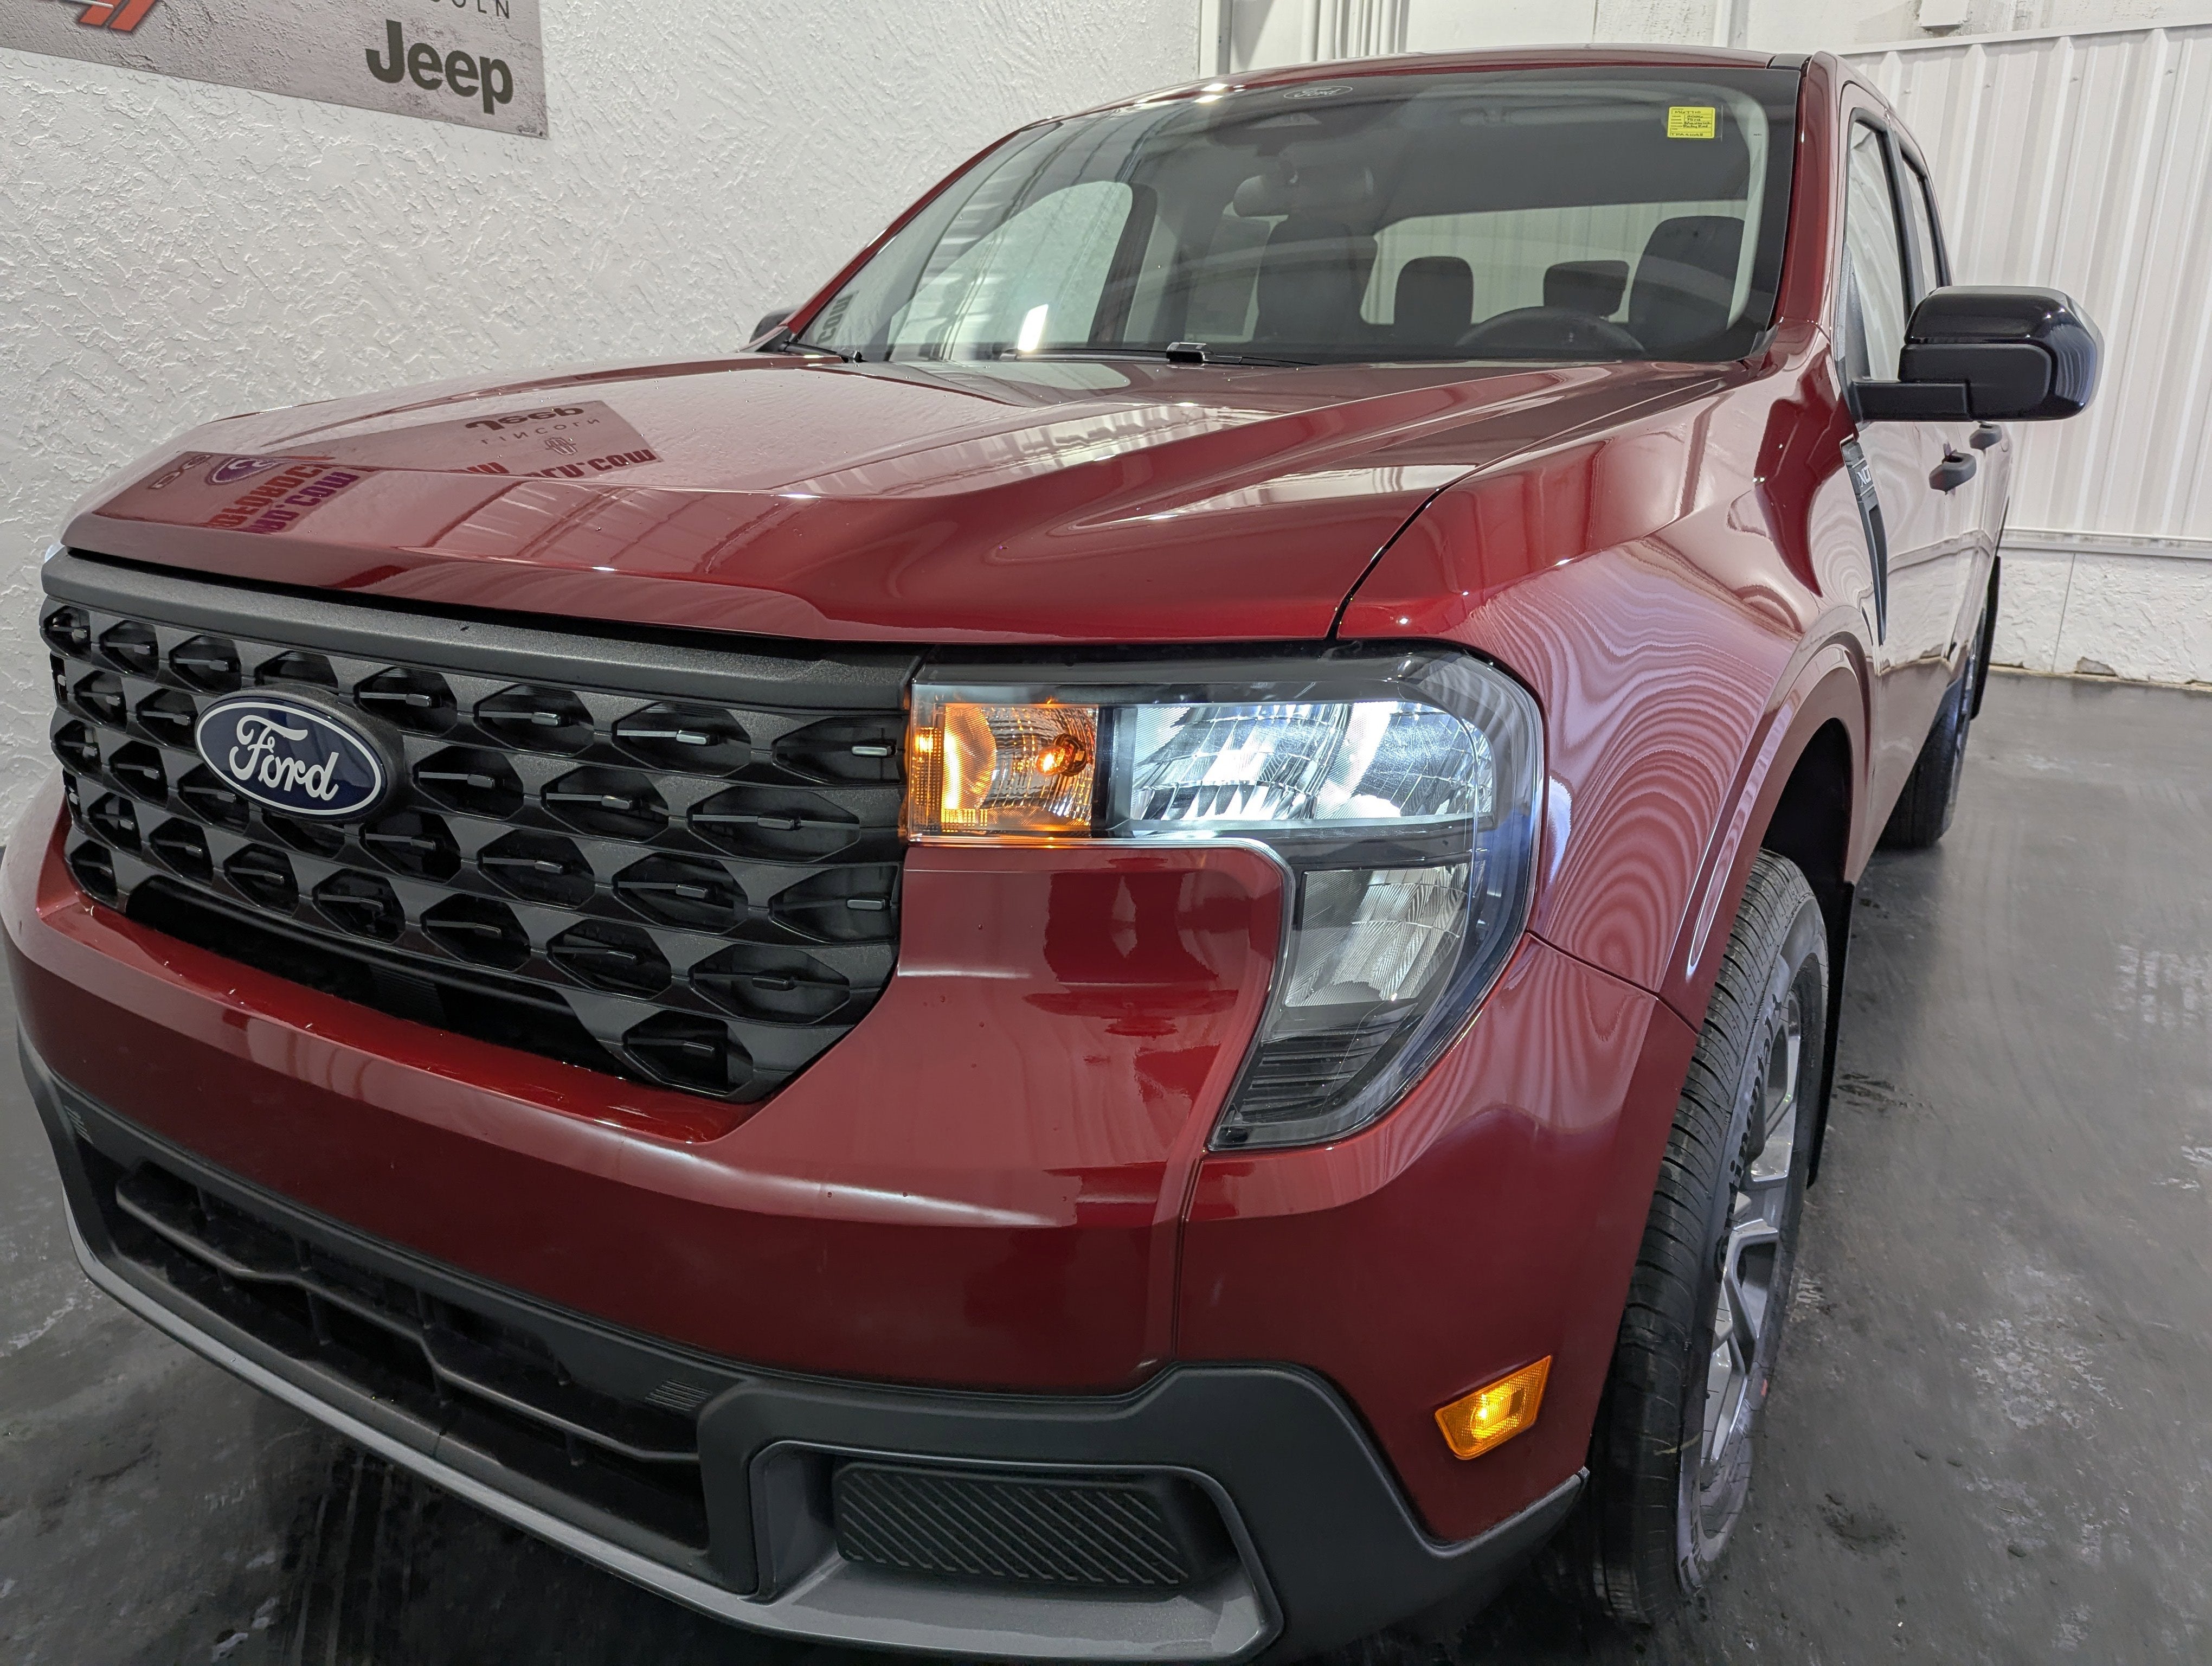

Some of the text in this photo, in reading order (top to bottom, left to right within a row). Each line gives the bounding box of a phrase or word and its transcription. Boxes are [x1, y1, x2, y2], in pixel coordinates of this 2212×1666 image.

[365, 19, 513, 116] Jeep
[1294, 87, 1341, 98] Ford
[229, 715, 339, 801] Ford
